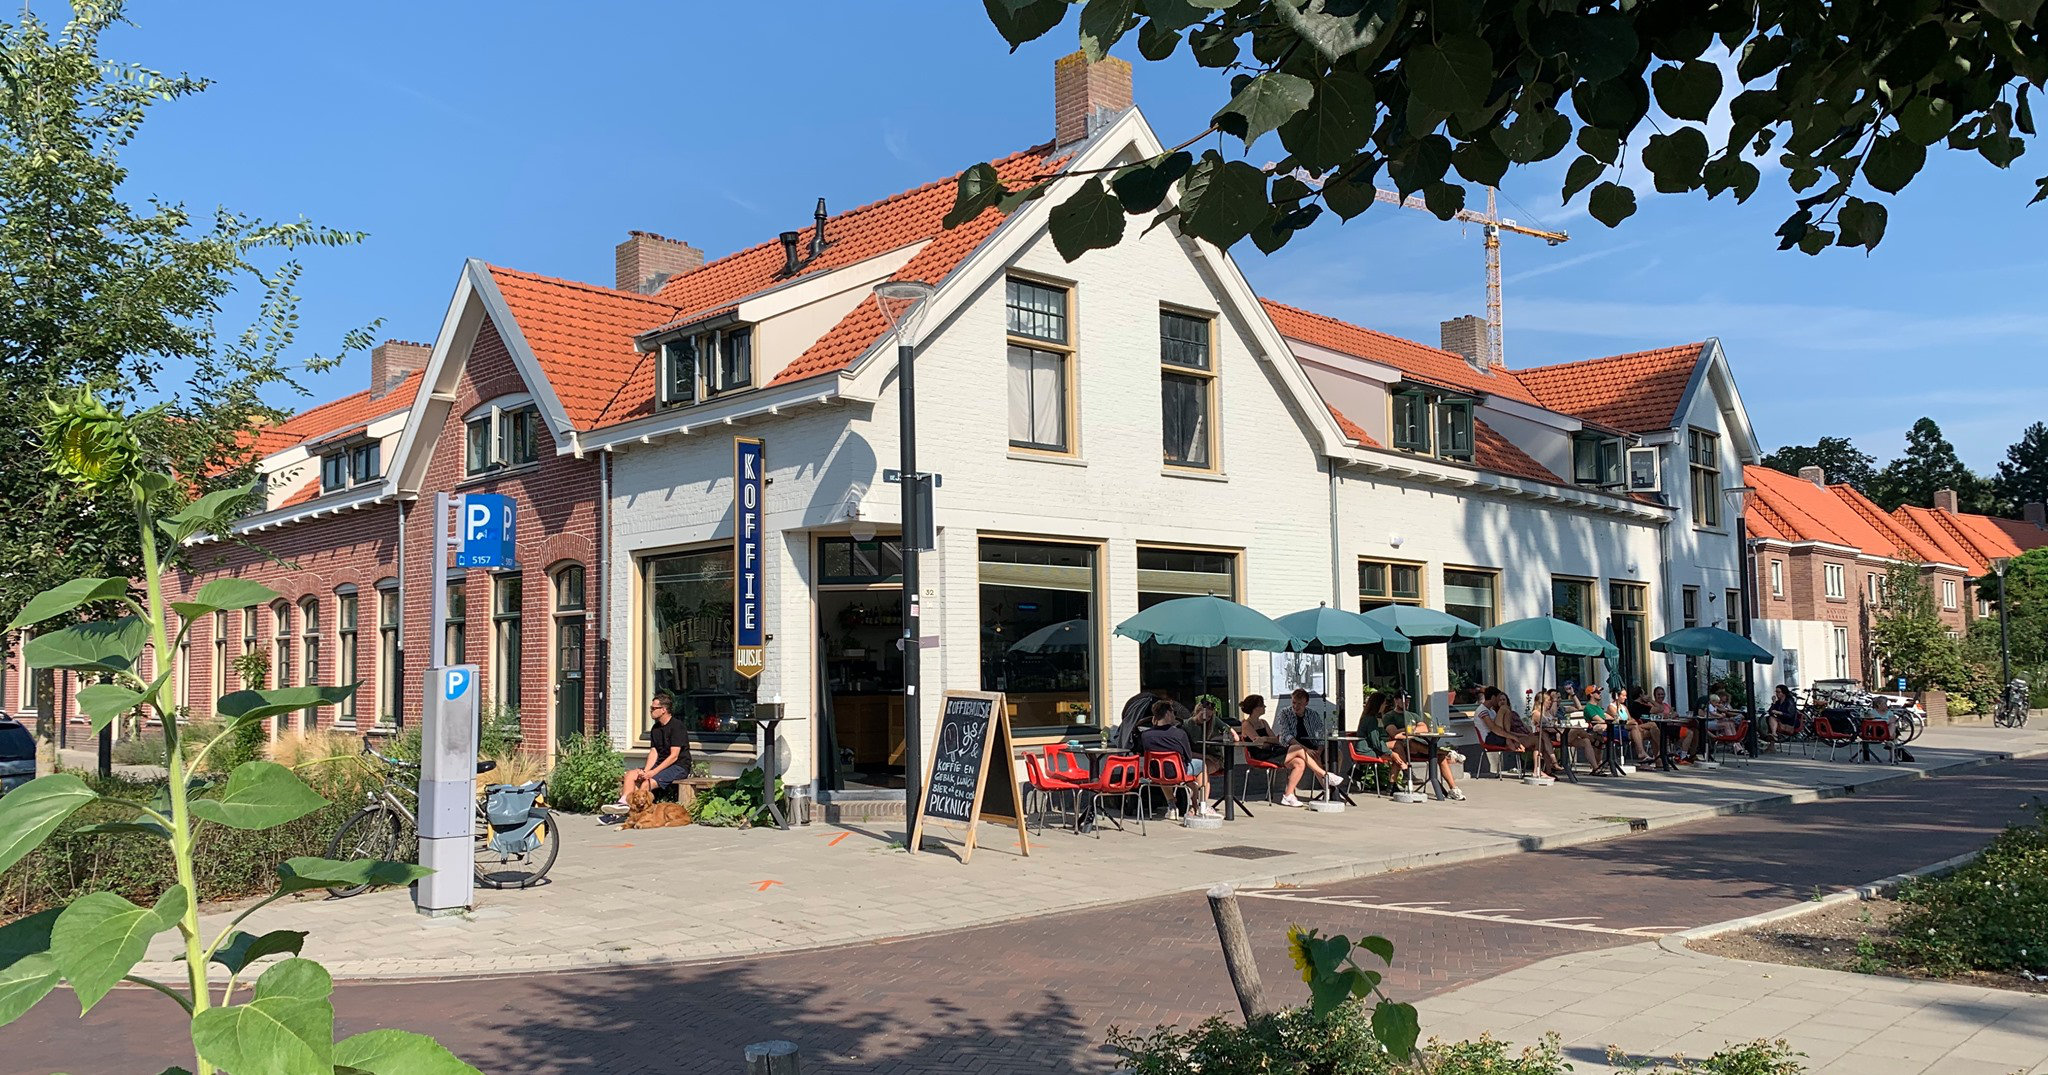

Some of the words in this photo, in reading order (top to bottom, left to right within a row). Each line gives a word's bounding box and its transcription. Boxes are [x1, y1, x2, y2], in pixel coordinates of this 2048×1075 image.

[467, 504, 491, 541] P
[744, 453, 756, 629] KOFFIE
[472, 555, 491, 564] 5157
[659, 616, 734, 656] KOFFIEHUIS
[738, 649, 762, 666] HUISJE
[448, 672, 464, 695] P
[937, 758, 962, 773] KOFFIE
[964, 764, 975, 775] EN
[956, 776, 975, 788] LUNCH
[929, 793, 972, 819] PICKNICK
